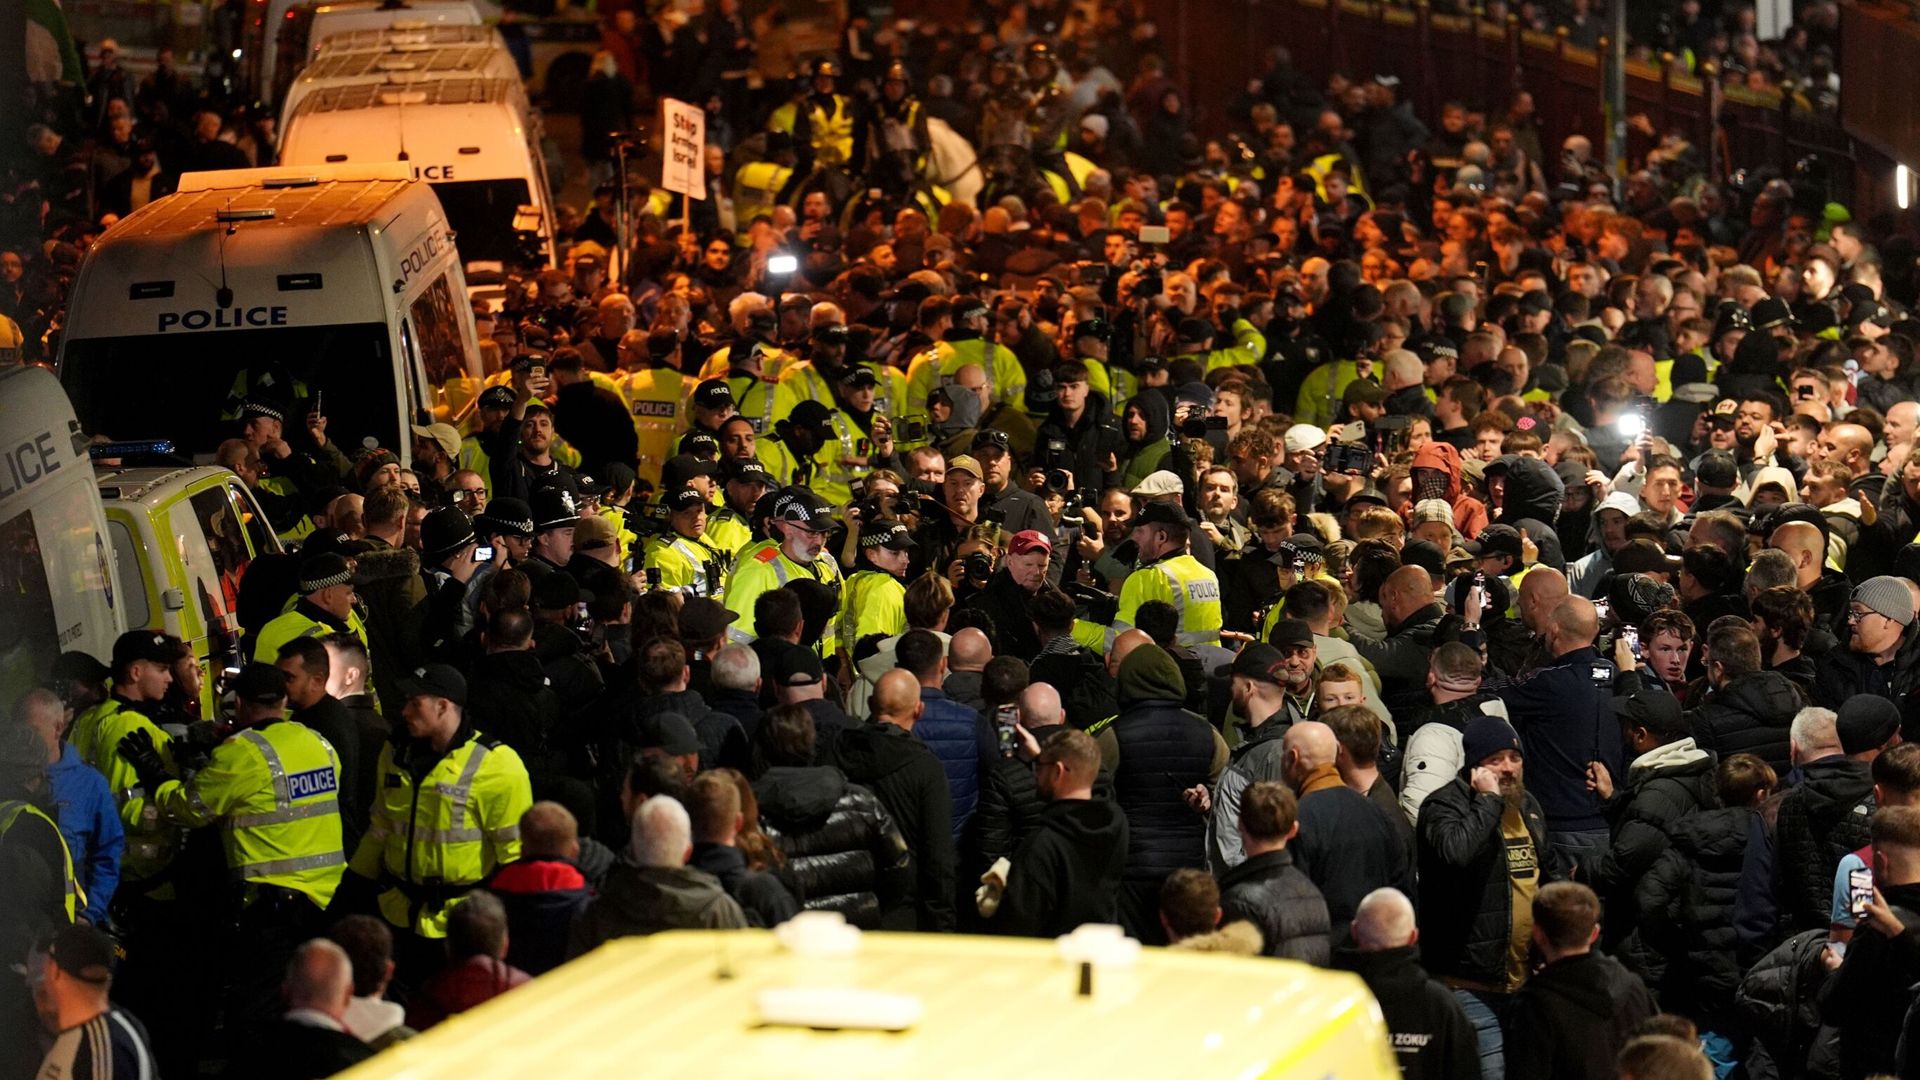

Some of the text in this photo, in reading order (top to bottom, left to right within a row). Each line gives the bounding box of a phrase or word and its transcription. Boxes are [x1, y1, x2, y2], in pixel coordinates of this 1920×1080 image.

[673, 113, 697, 136] Stop
[414, 165, 455, 180] ICE
[400, 229, 443, 283] POLICE
[158, 306, 288, 332] POLICE
[633, 402, 674, 416] POLICE
[289, 769, 335, 797] POLICE
[1394, 1032, 1429, 1046] ZOKU
